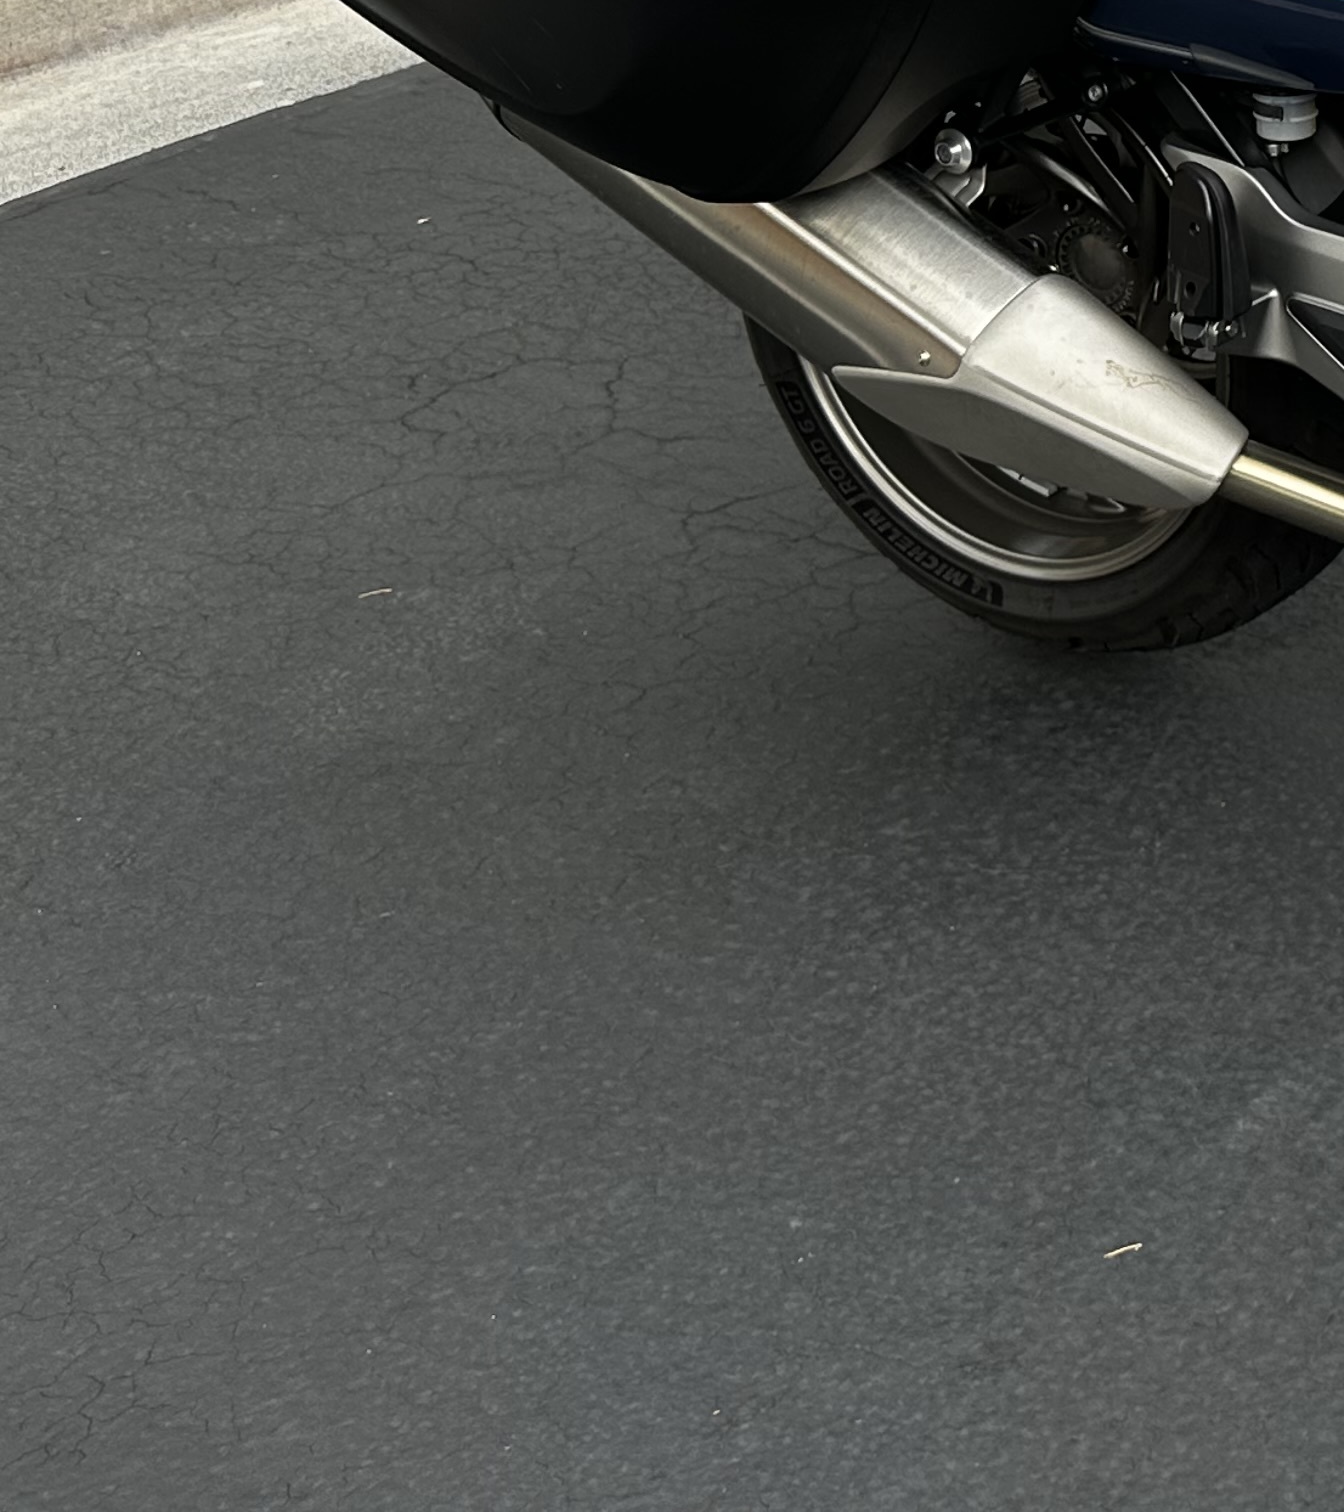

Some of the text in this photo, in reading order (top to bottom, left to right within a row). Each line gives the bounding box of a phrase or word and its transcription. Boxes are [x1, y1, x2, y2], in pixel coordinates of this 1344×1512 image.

[781, 386, 970, 589] MICHELIN ROAD 6 GT
